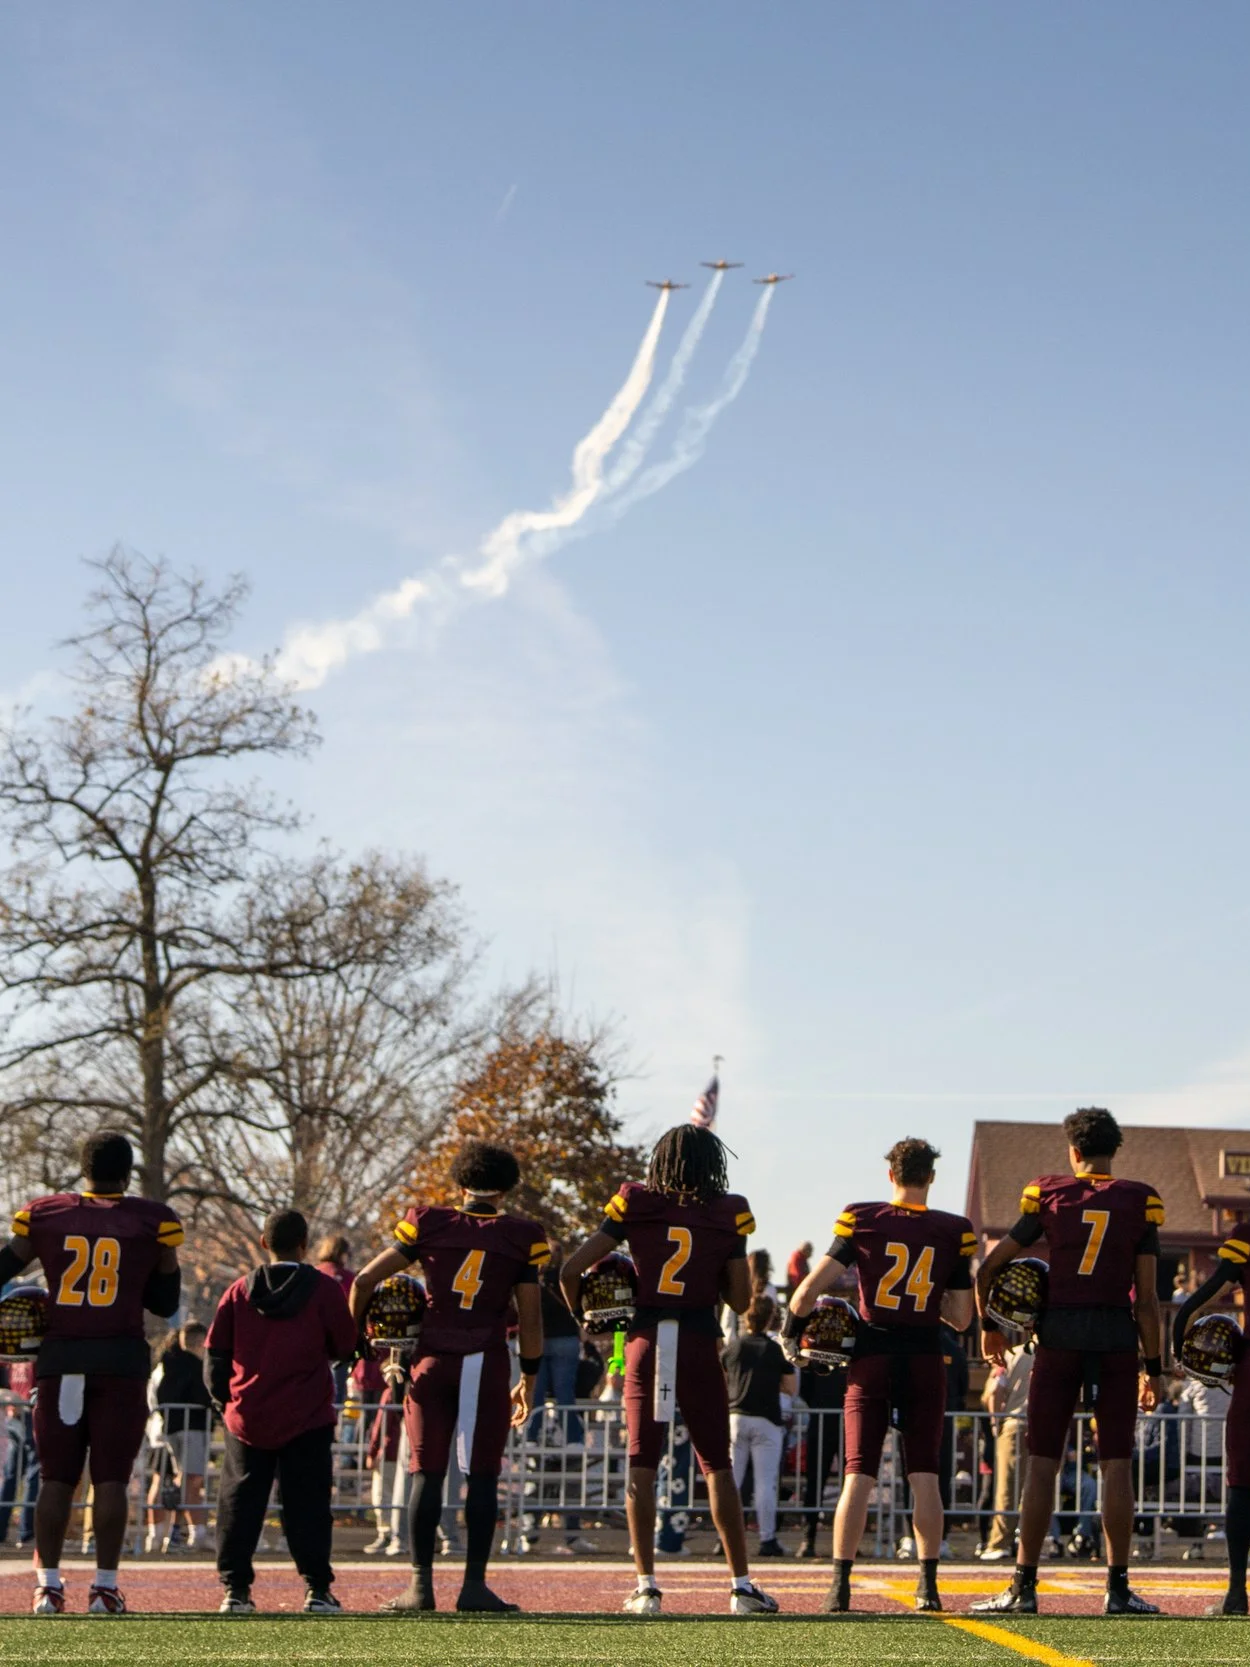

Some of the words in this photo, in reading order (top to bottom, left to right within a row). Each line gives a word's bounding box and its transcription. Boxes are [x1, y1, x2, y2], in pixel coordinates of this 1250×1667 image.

[56, 1235, 121, 1307] 28
[657, 1227, 693, 1295] 2
[1077, 1209, 1110, 1275] 7
[451, 1249, 486, 1310] 4
[874, 1241, 935, 1312] 24
